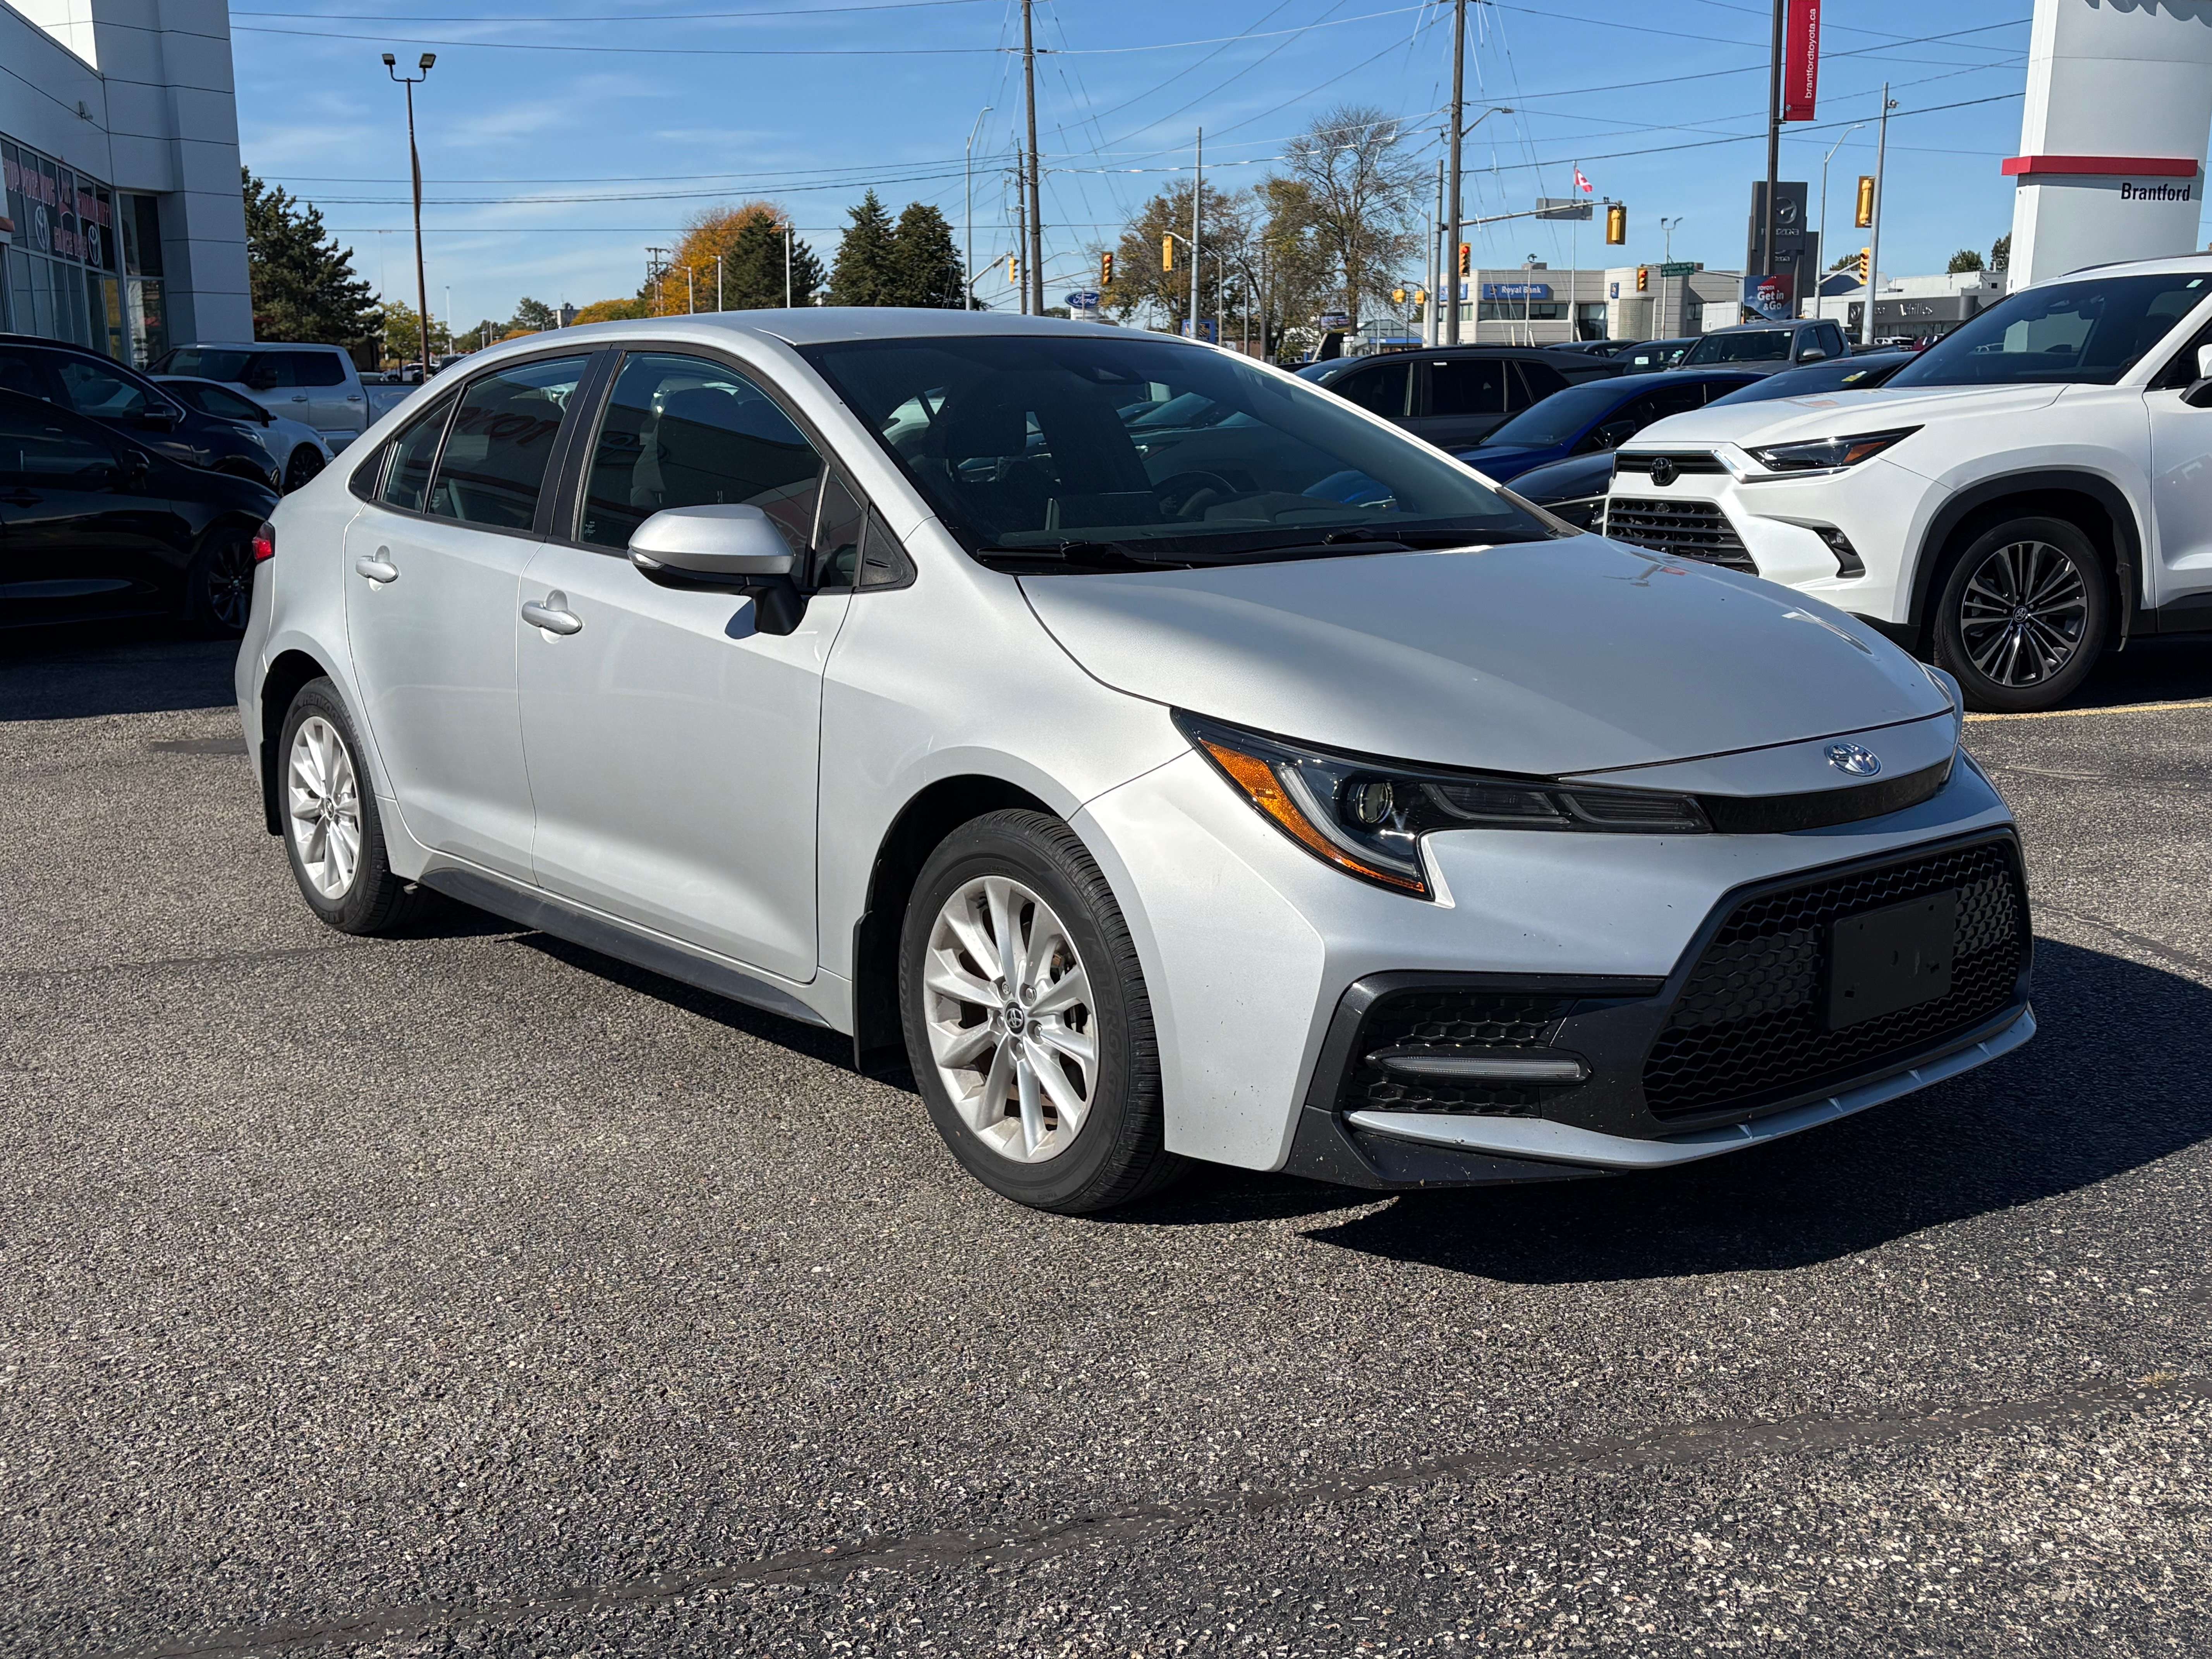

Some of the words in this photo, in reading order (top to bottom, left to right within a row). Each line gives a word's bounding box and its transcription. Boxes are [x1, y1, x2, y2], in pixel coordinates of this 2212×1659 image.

[1805, 8, 1817, 98] brantfordtoyota.ca
[2121, 182, 2191, 201] Brantford
[1501, 286, 1522, 295] Royal
[1757, 291, 1775, 301] Get
[1776, 290, 1784, 300] in
[1073, 293, 1097, 304] Ford
[1900, 303, 1933, 316] Achilles
